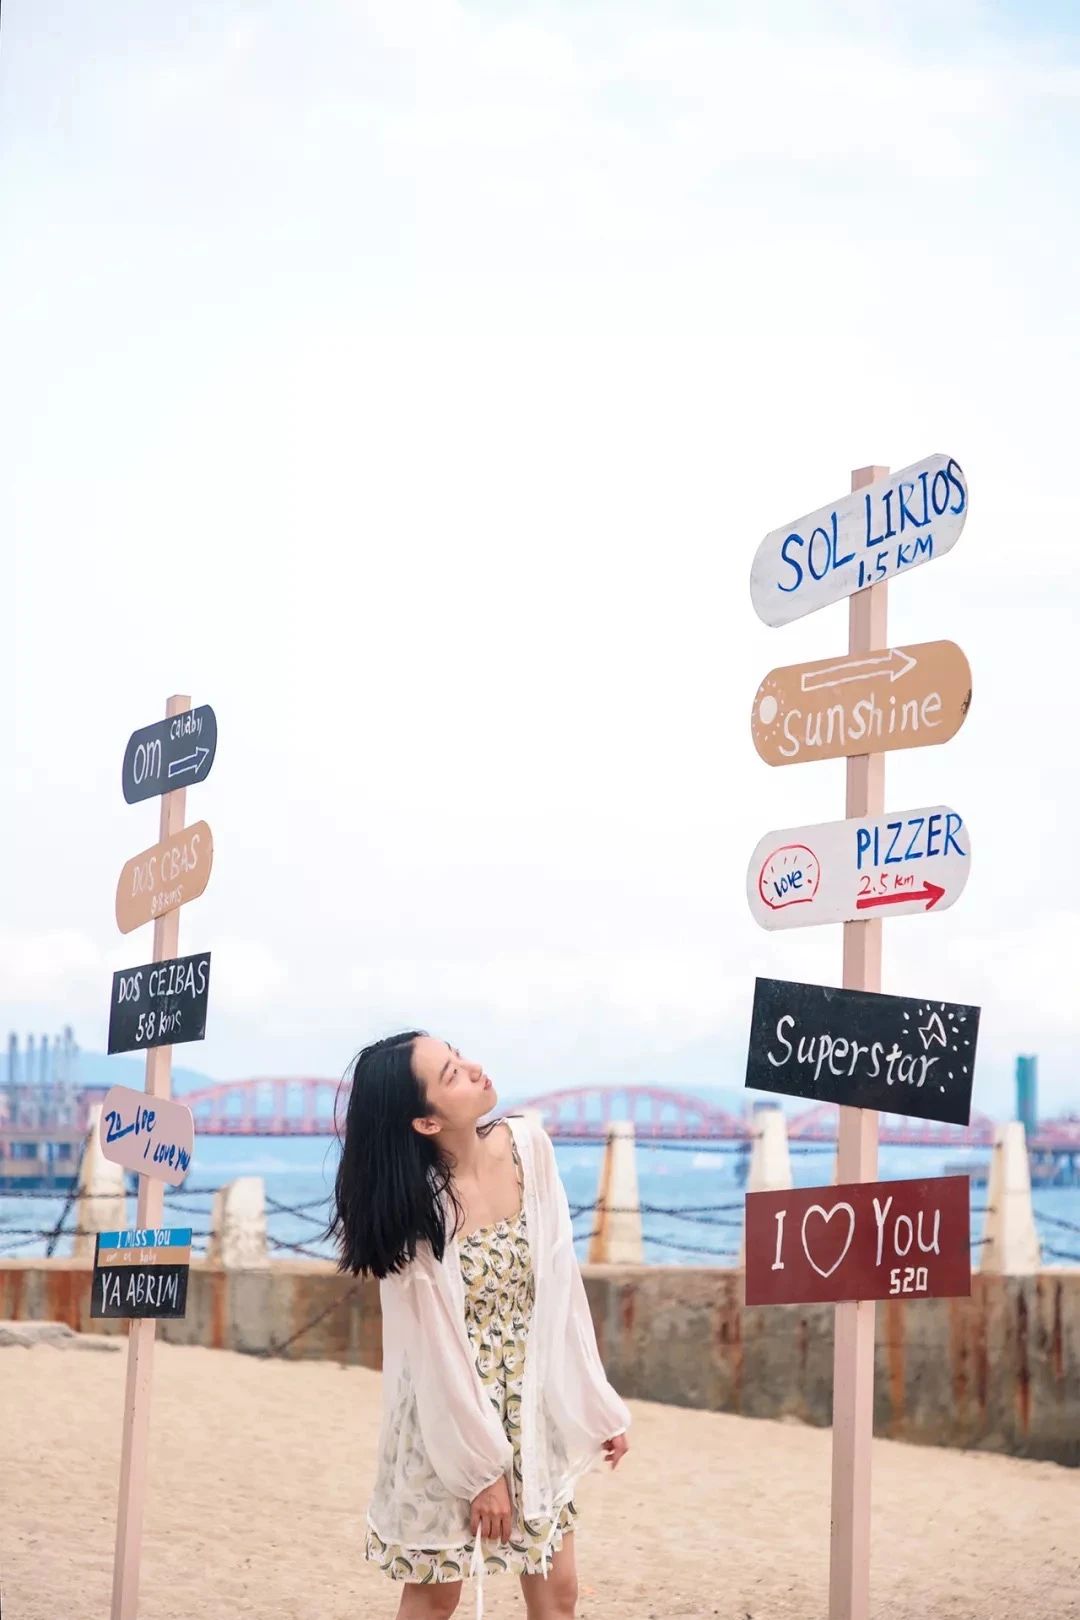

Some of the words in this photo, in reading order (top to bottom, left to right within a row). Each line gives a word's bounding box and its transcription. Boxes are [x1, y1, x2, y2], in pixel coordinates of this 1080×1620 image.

[778, 511, 856, 592] SOL
[865, 458, 966, 547] LIRIOS
[858, 551, 888, 587] 1.5
[897, 534, 933, 568] KM
[857, 813, 966, 870] PIZZER
[857, 873, 888, 896] 2.5
[118, 971, 143, 1003] DOS
[148, 960, 208, 998] CEIBAS
[767, 1014, 941, 1087] Superstar
[770, 1210, 787, 1271] I
[101, 1272, 121, 1313] YA
[126, 1272, 179, 1309] ABRIM
[889, 1267, 928, 1295] 520
